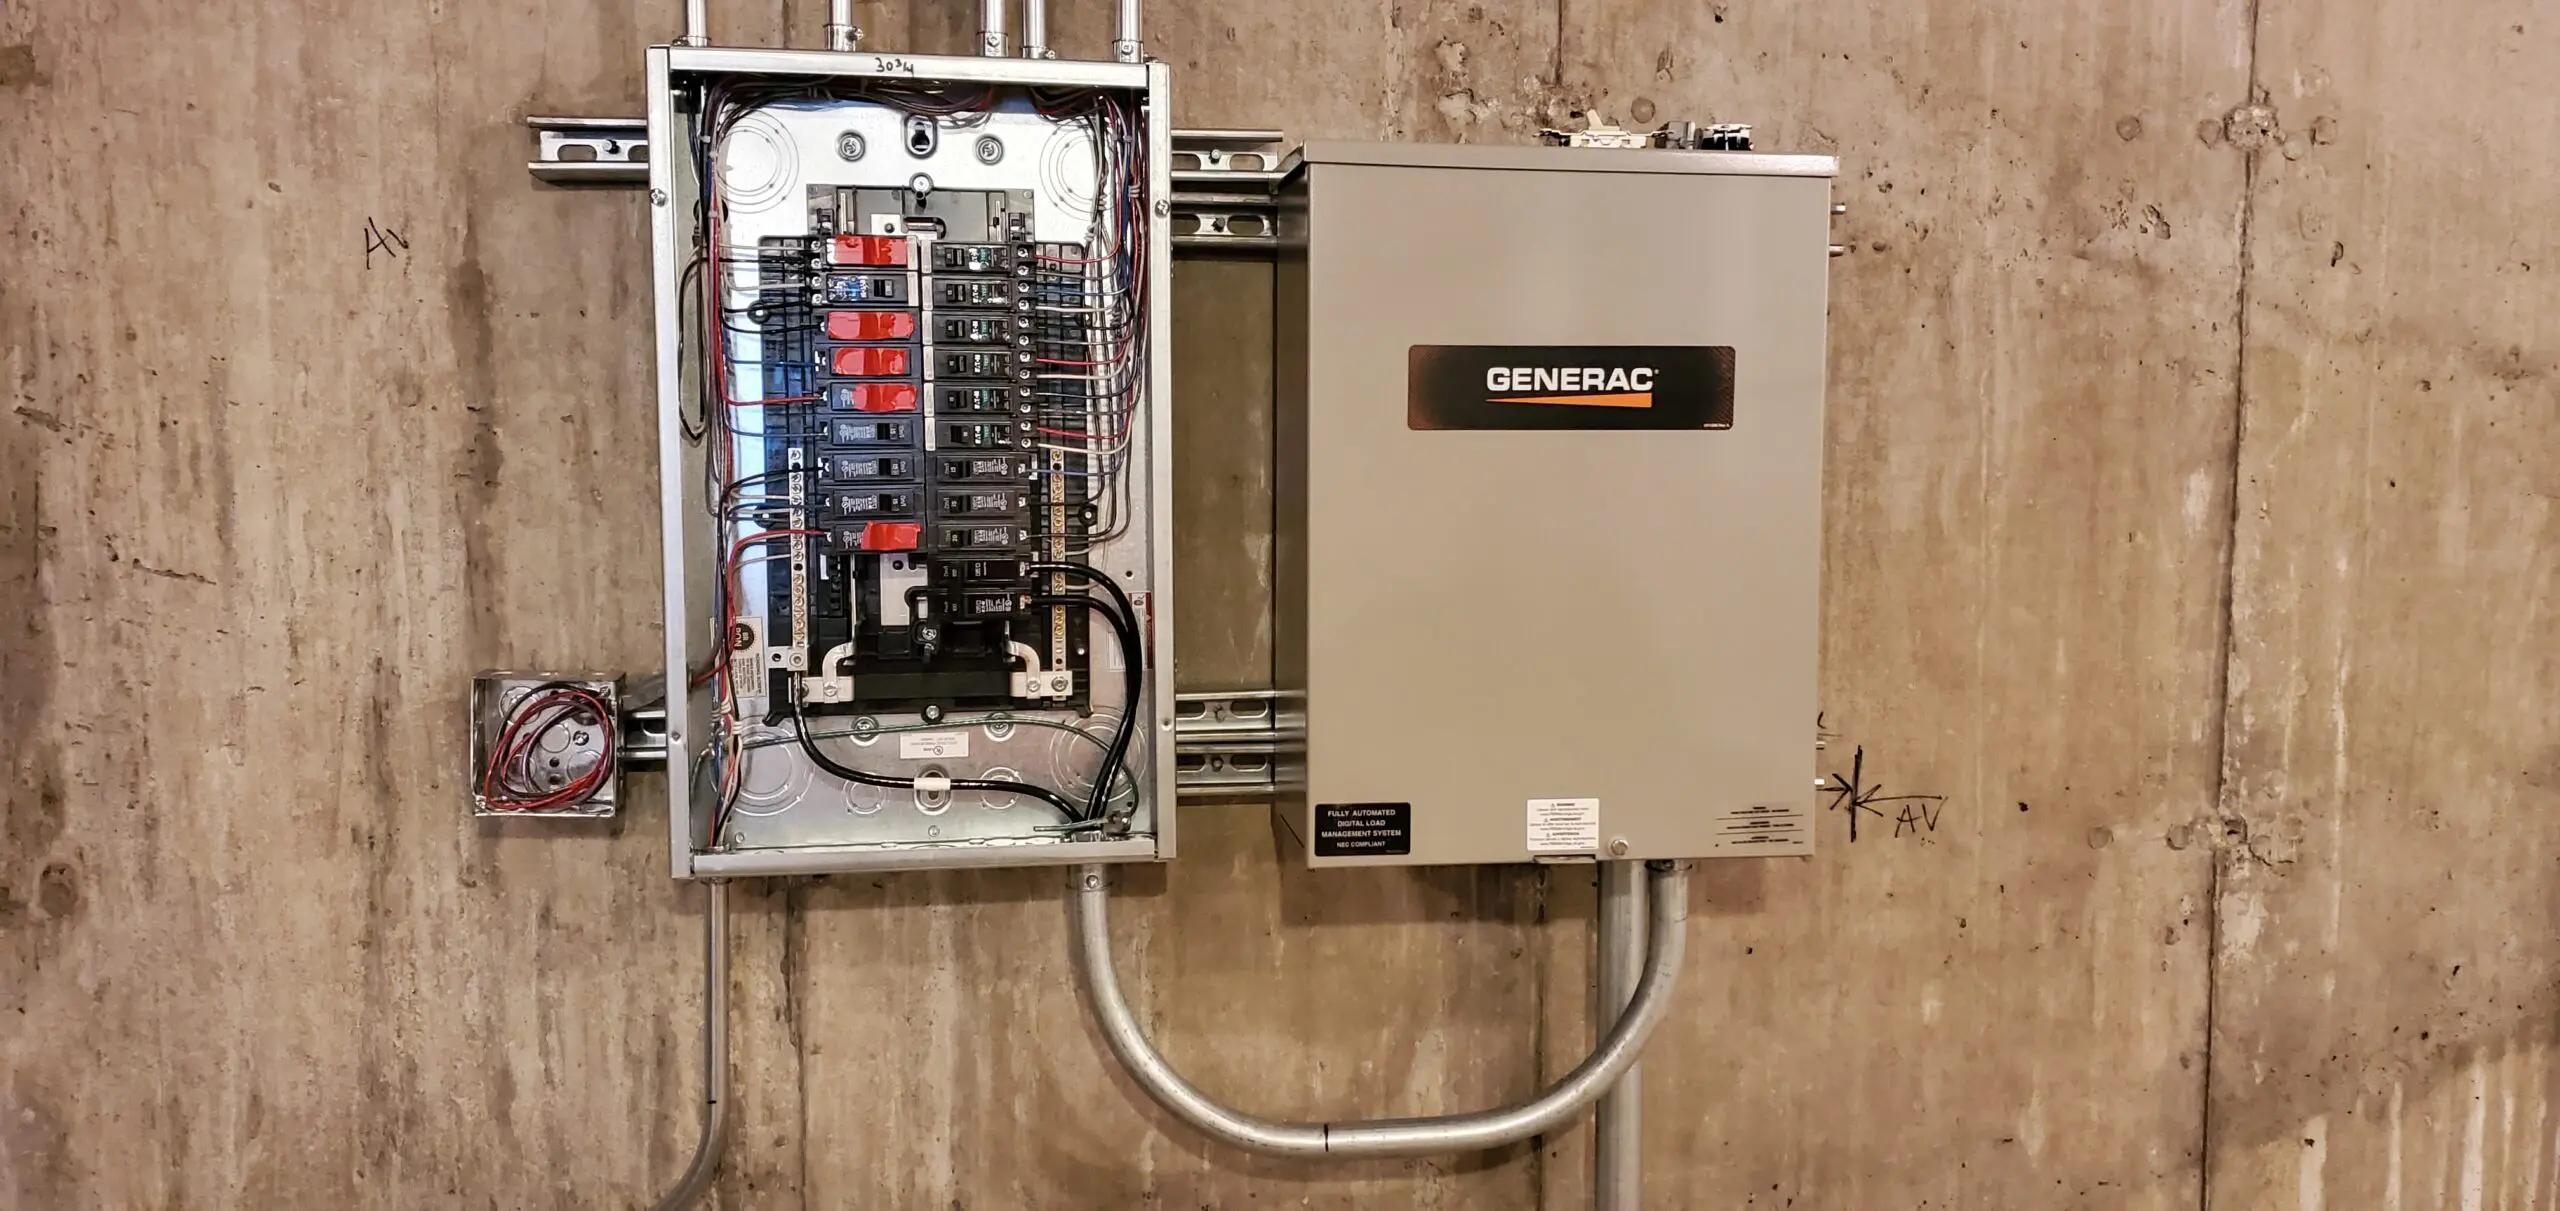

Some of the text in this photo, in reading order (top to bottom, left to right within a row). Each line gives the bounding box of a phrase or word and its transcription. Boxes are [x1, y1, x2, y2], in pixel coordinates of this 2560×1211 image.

[1486, 367, 1653, 392] GENERAC
[1352, 809, 1396, 817] AUTOMATED
[1895, 796, 1949, 838] AV
[1321, 829, 1401, 838] MANAGEMENT SYSTEM
